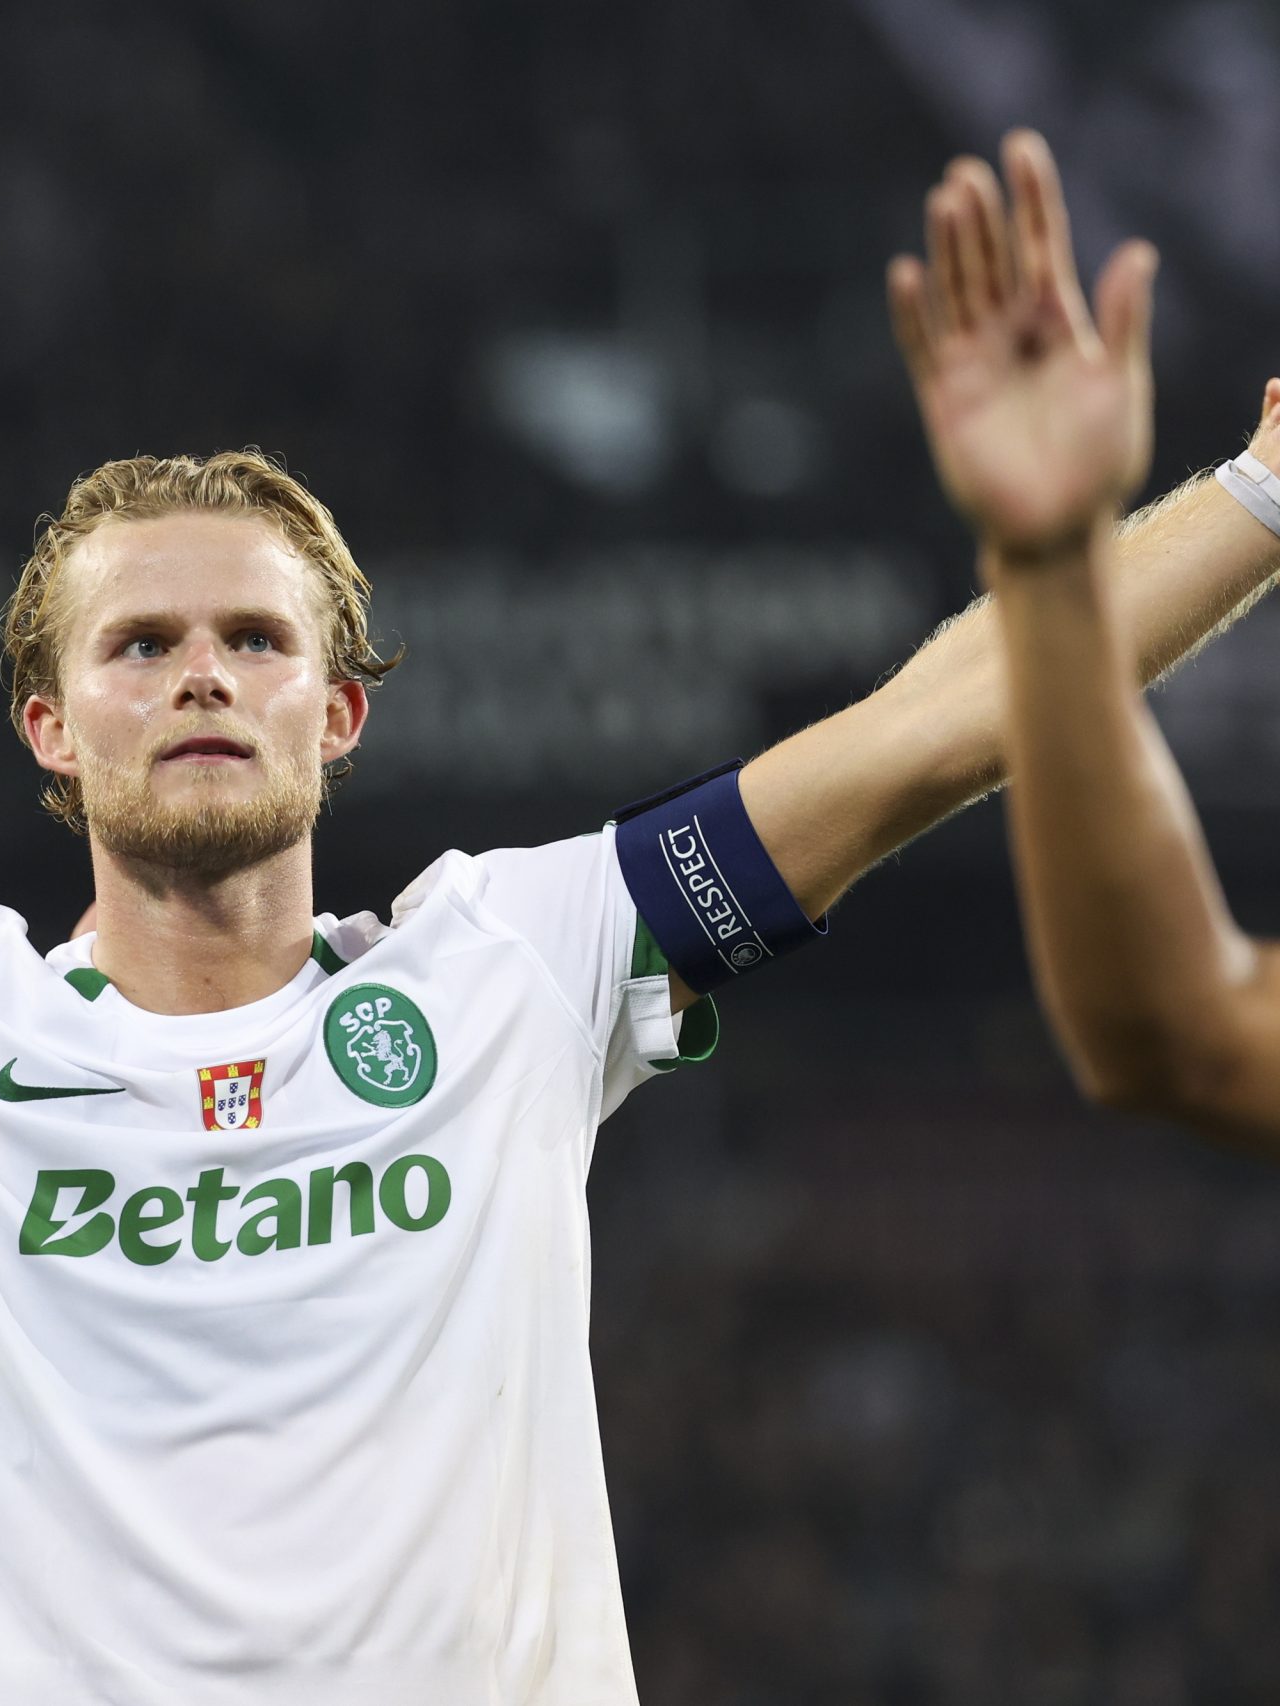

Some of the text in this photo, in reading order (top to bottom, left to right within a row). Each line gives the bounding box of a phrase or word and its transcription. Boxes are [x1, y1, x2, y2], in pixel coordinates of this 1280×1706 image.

[667, 824, 743, 941] RESPECT
[338, 996, 393, 1033] SCP
[19, 1153, 452, 1267] Betano
